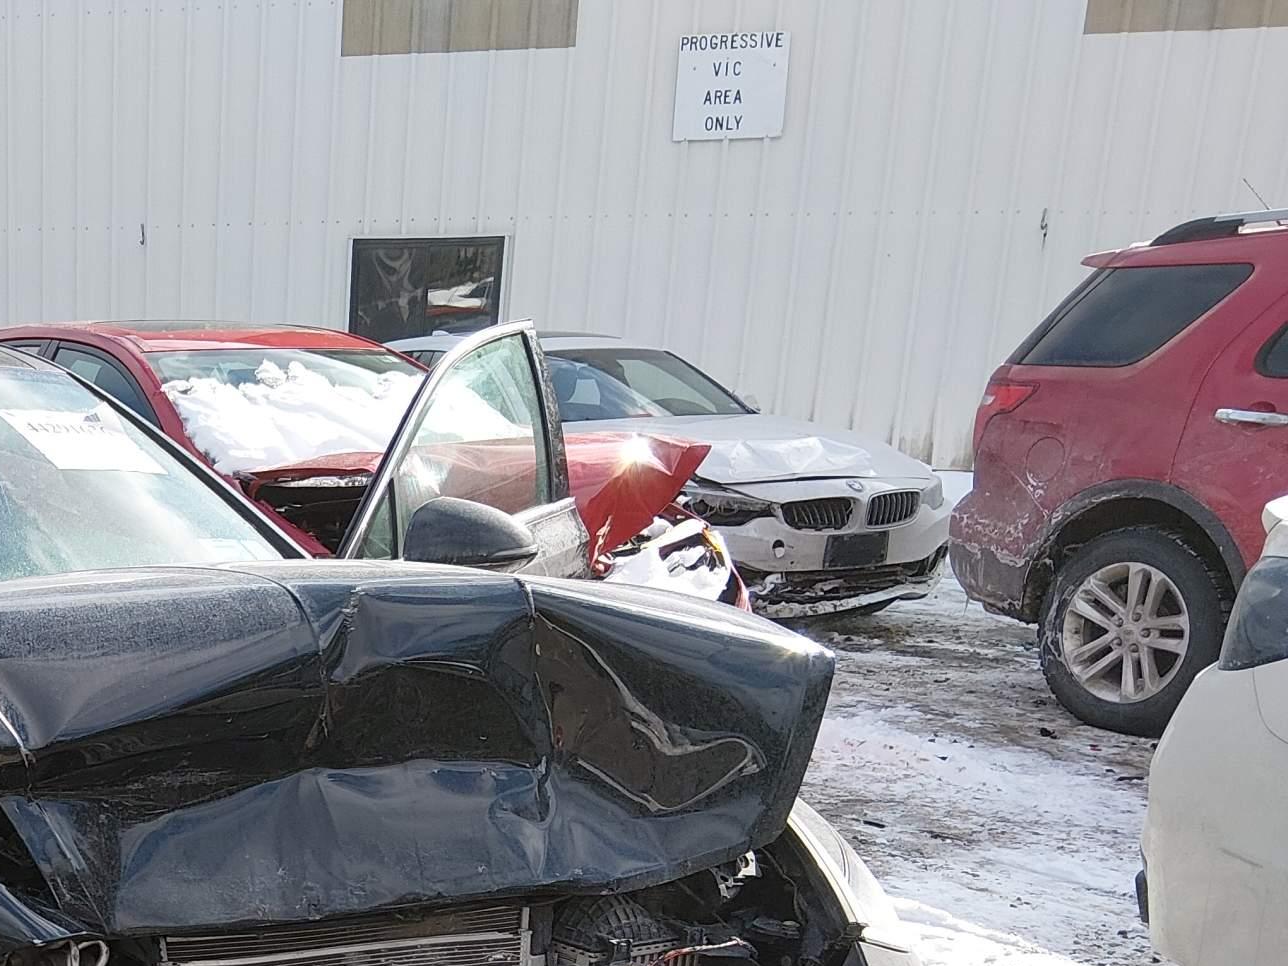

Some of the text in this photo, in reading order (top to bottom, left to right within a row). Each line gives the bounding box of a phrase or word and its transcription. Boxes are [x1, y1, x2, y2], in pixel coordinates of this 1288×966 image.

[680, 32, 785, 52] PROGRESSIVE
[712, 60, 742, 77] VIC
[703, 89, 743, 105] AREA
[704, 115, 743, 131] ONLY
